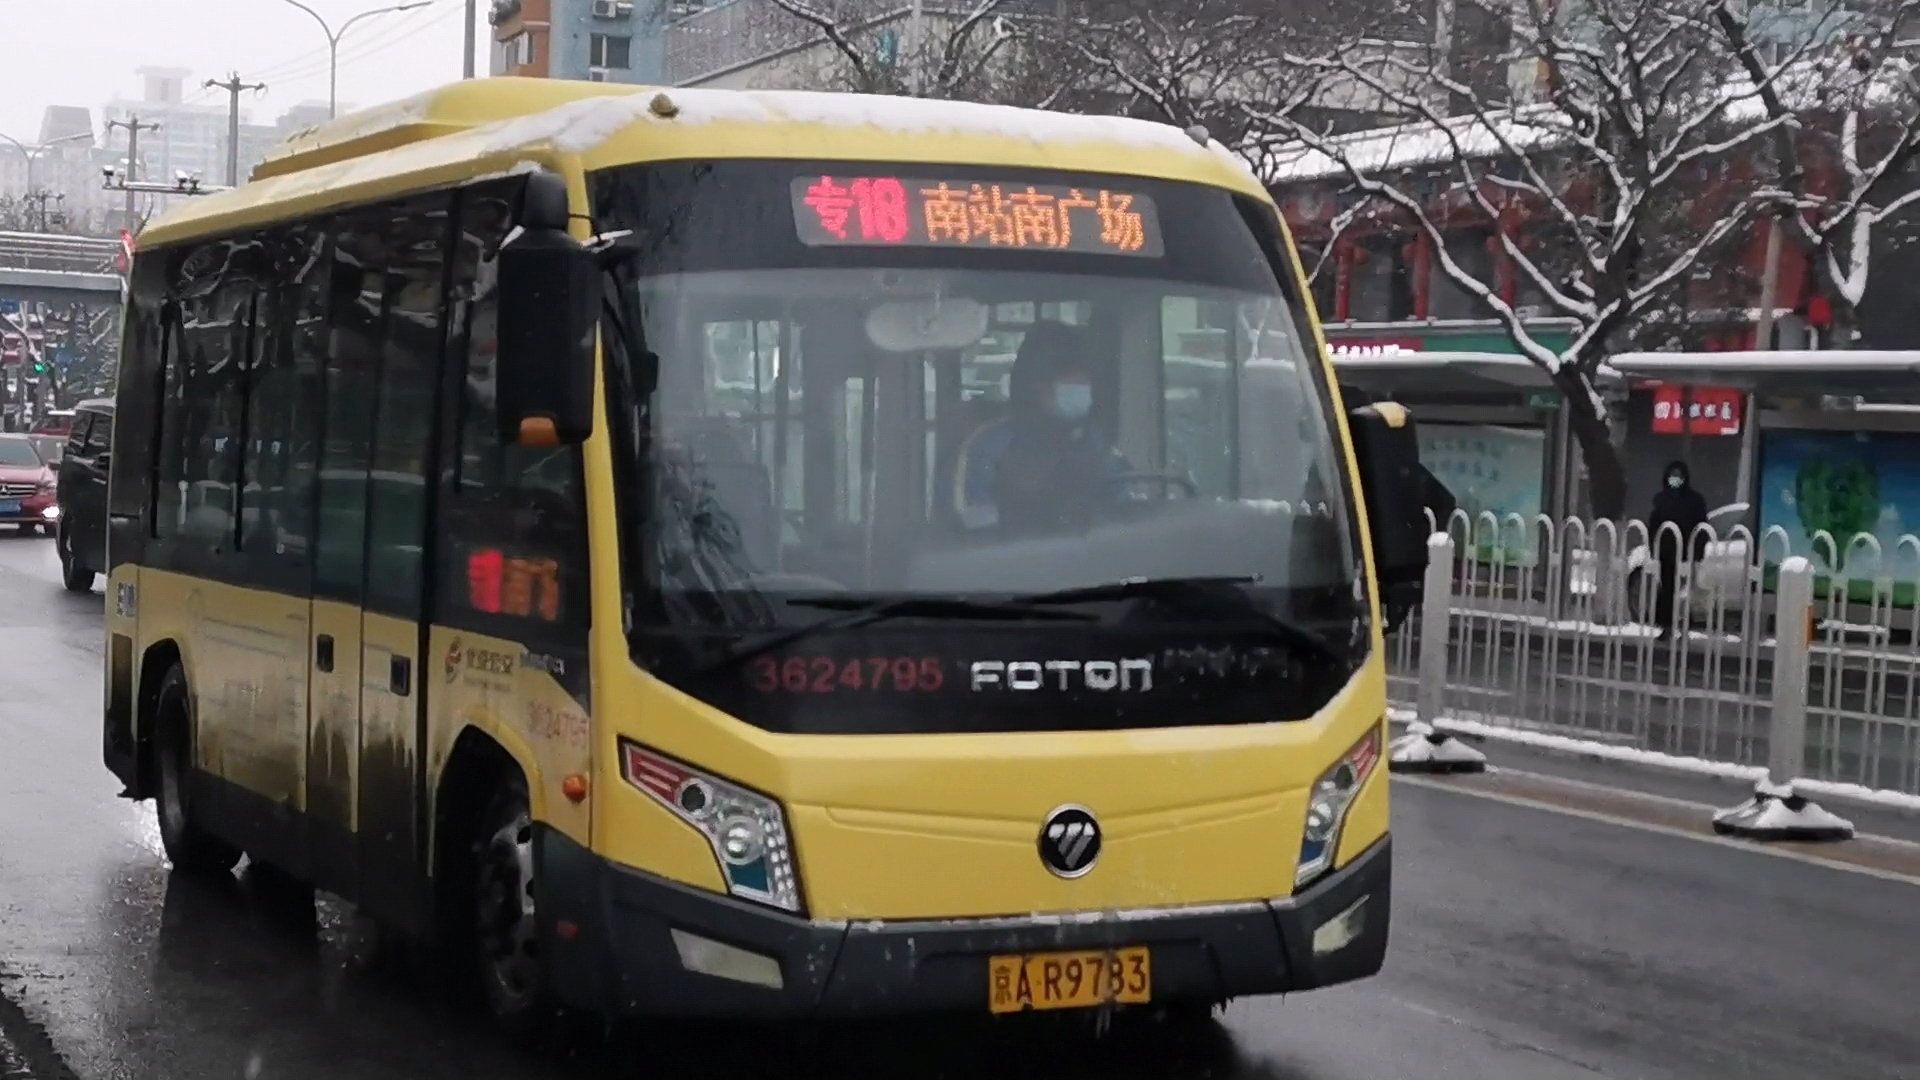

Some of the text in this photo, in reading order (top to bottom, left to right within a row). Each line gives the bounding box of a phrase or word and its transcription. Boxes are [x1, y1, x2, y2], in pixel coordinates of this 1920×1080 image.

[805, 176, 1145, 250] 专18 南站南广场
[754, 656, 944, 693] 3624795
[971, 656, 1154, 692] FOTON
